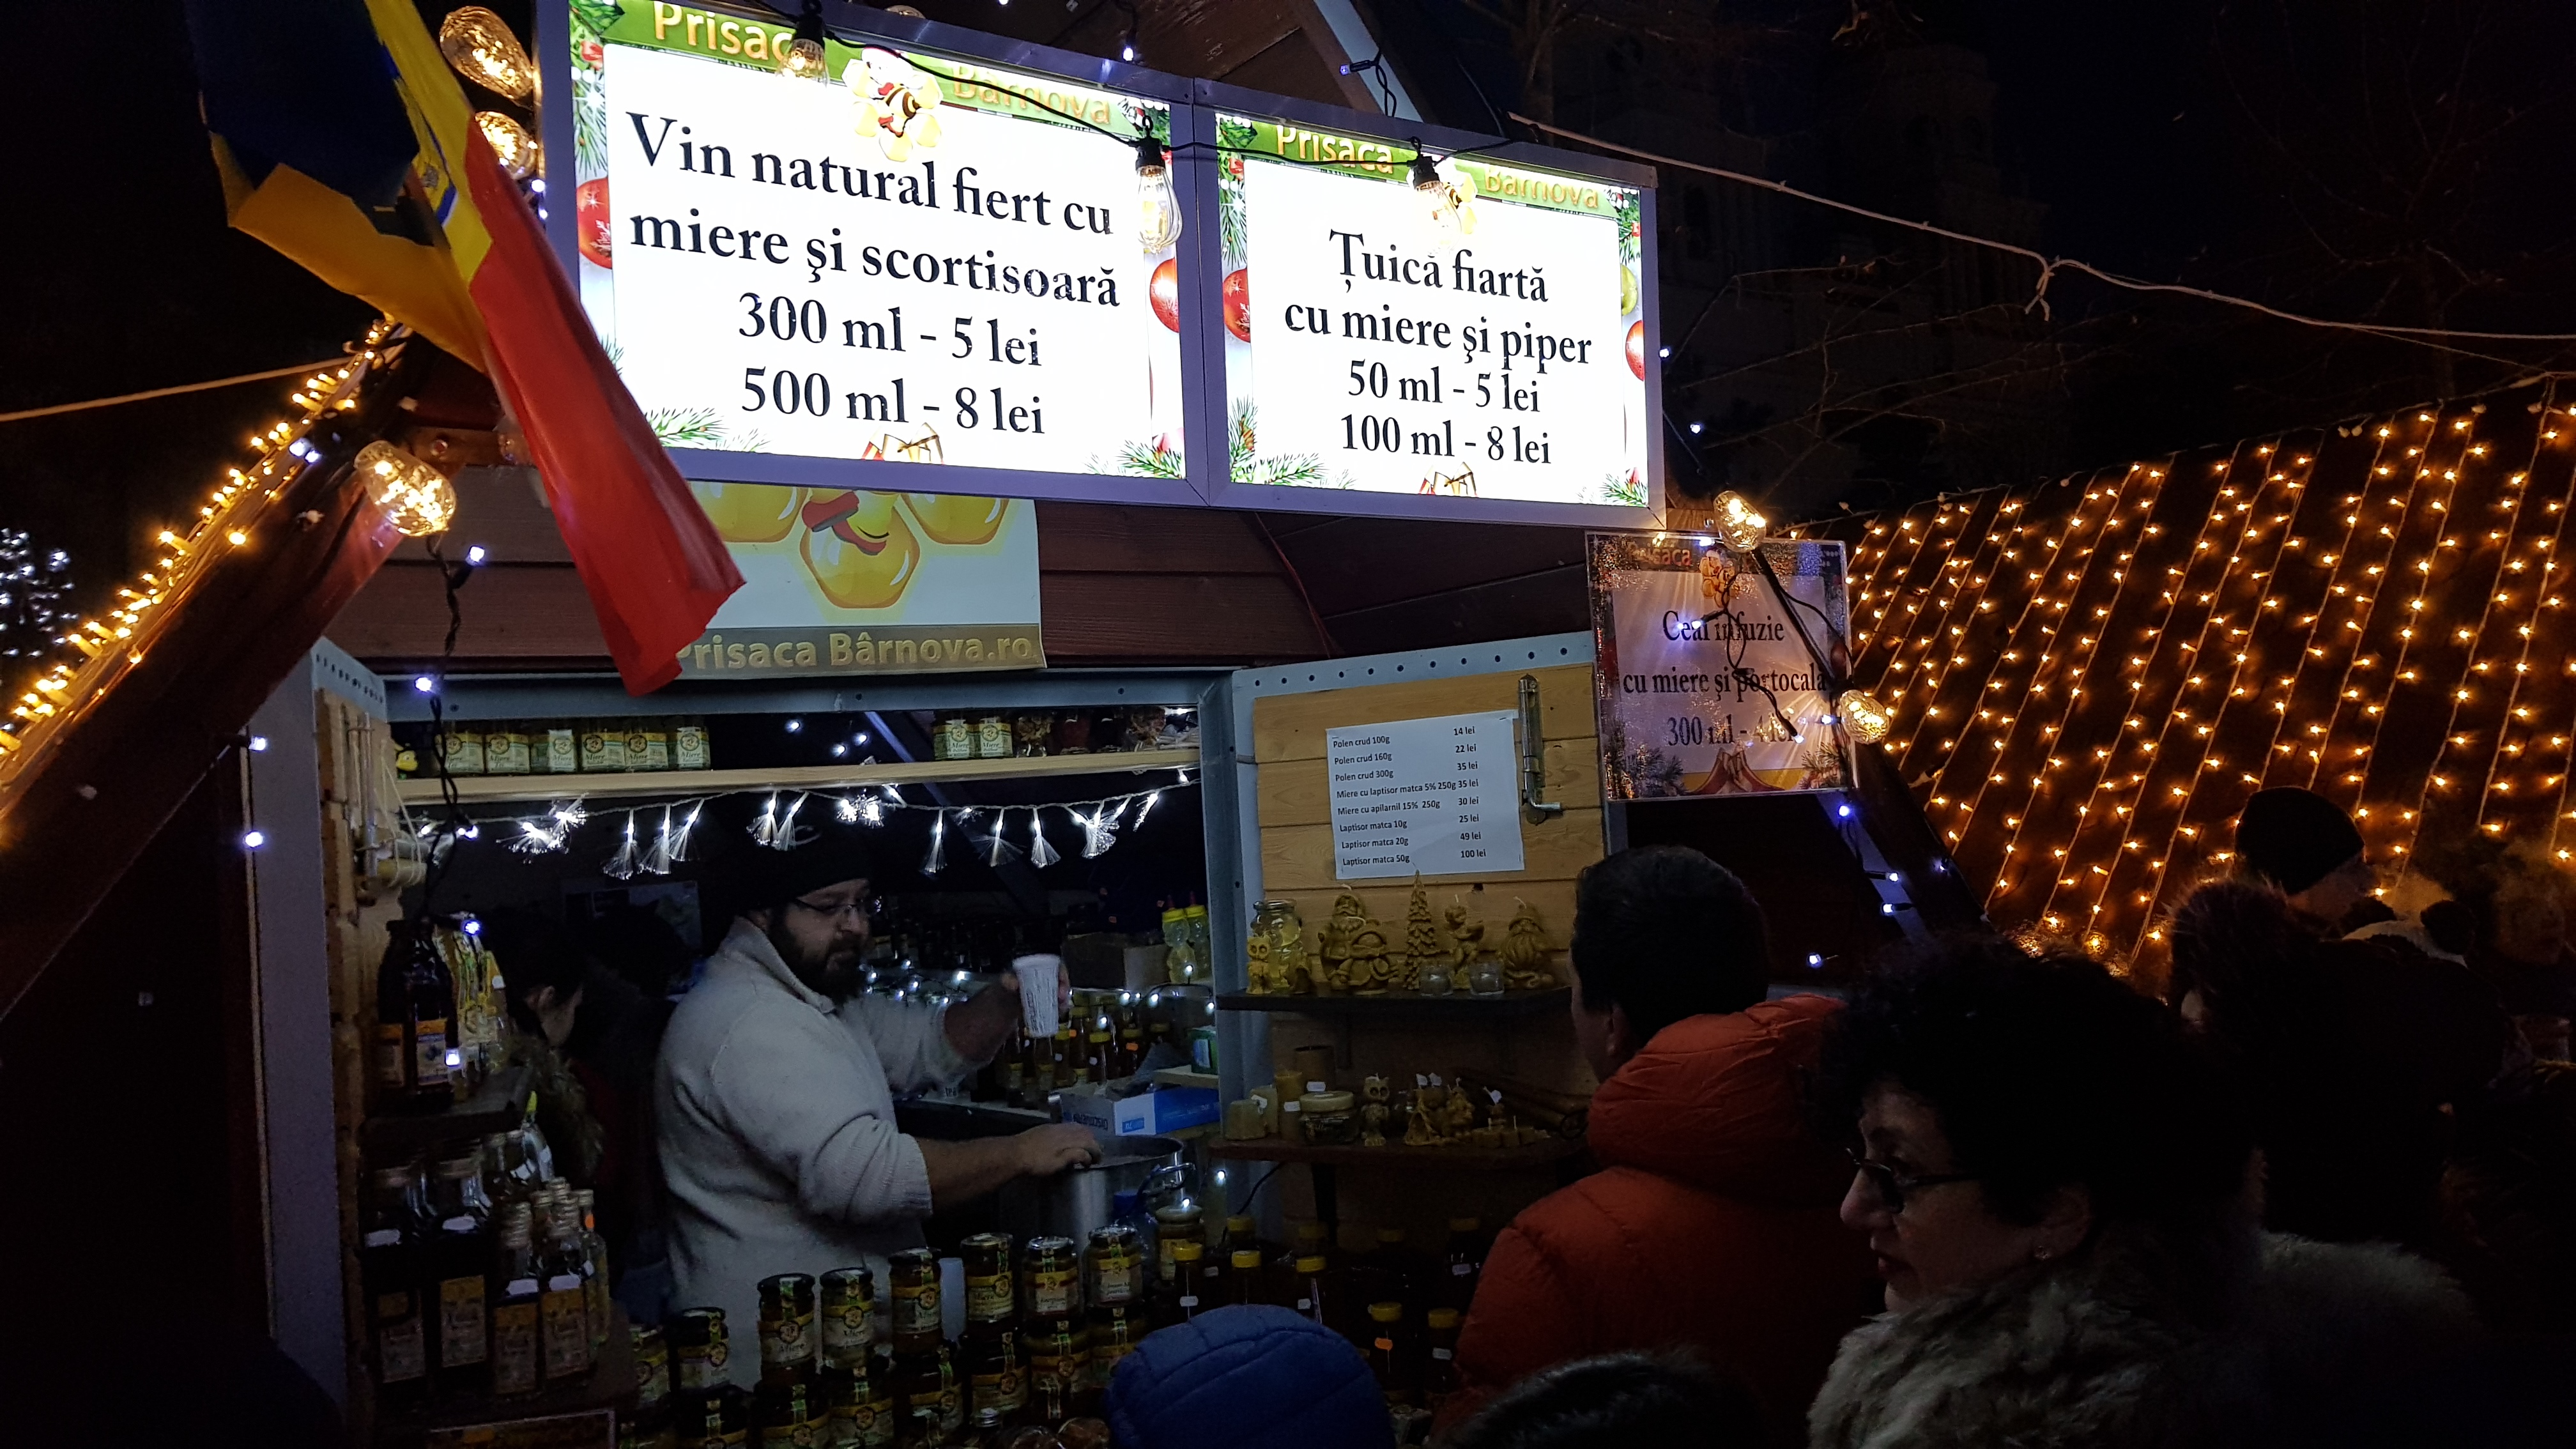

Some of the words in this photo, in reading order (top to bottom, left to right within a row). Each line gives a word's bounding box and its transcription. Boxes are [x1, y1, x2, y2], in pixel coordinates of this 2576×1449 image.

[653, 1, 799, 63] Prisac
[1276, 124, 1394, 174] Prisaca
[626, 112, 735, 178] Vin
[751, 153, 940, 209] natural
[953, 167, 1051, 226] fiert
[1064, 203, 1113, 234] cu
[630, 208, 789, 264] miere
[863, 247, 1120, 307] scortisoară
[1453, 249, 1548, 302] fiartă
[739, 293, 826, 343] 300
[843, 307, 906, 351] ml
[952, 317, 972, 358] 5
[987, 319, 1041, 366] lei
[1285, 303, 1331, 334] cu
[1342, 304, 1451, 348] miere
[1501, 322, 1591, 374] piper
[742, 367, 830, 417] 500
[846, 378, 908, 422] ml
[956, 387, 978, 428] 8
[990, 388, 1045, 433] lei
[1349, 359, 1388, 398] 50
[1399, 366, 1443, 403] ml
[1476, 372, 1491, 407] 5
[1501, 374, 1540, 411] lei
[1342, 414, 1400, 452] 100
[1411, 420, 1454, 457] ml
[1487, 426, 1503, 461] 8
[1513, 426, 1551, 463] lei
[1629, 542, 1691, 565] Pisaca
[676, 634, 818, 669] risaca
[829, 632, 1033, 666] Bârnova.ro
[1623, 674, 1648, 693] cu
[1653, 666, 1710, 693] miere
[1333, 739, 1354, 748] Polen
[1355, 737, 1371, 746] crud
[1372, 736, 1390, 745] 100g
[1466, 726, 1475, 735] lei
[1667, 716, 1703, 746] 300
[1335, 756, 1355, 765] Polen
[1356, 754, 1373, 763] crud
[1375, 753, 1392, 762] 160g
[1455, 745, 1465, 753] 22
[1467, 744, 1476, 752] lei
[1335, 773, 1356, 781] Polen
[1358, 771, 1374, 780] crud
[1376, 770, 1394, 779] 300g
[1468, 762, 1478, 770] lei
[1337, 790, 1358, 799] Miere
[1370, 786, 1399, 797] laptisor
[1425, 783, 1436, 791] 5%
[1438, 781, 1457, 790] 250g
[1469, 779, 1479, 787] lei
[1337, 807, 1359, 815] Miere
[1370, 803, 1401, 814] apilarnil
[1402, 802, 1418, 810] 15%
[1422, 801, 1441, 809] 250g
[1469, 796, 1479, 804] lei
[1339, 823, 1368, 833] Laptisor
[1393, 820, 1407, 829] 10g
[1341, 840, 1370, 850] Laptisor
[1395, 838, 1409, 847] 20g
[1342, 857, 1371, 867] Laptisor
[1396, 855, 1410, 863] 50g
[1460, 850, 1475, 858] 100
[1476, 848, 1487, 857] lei
